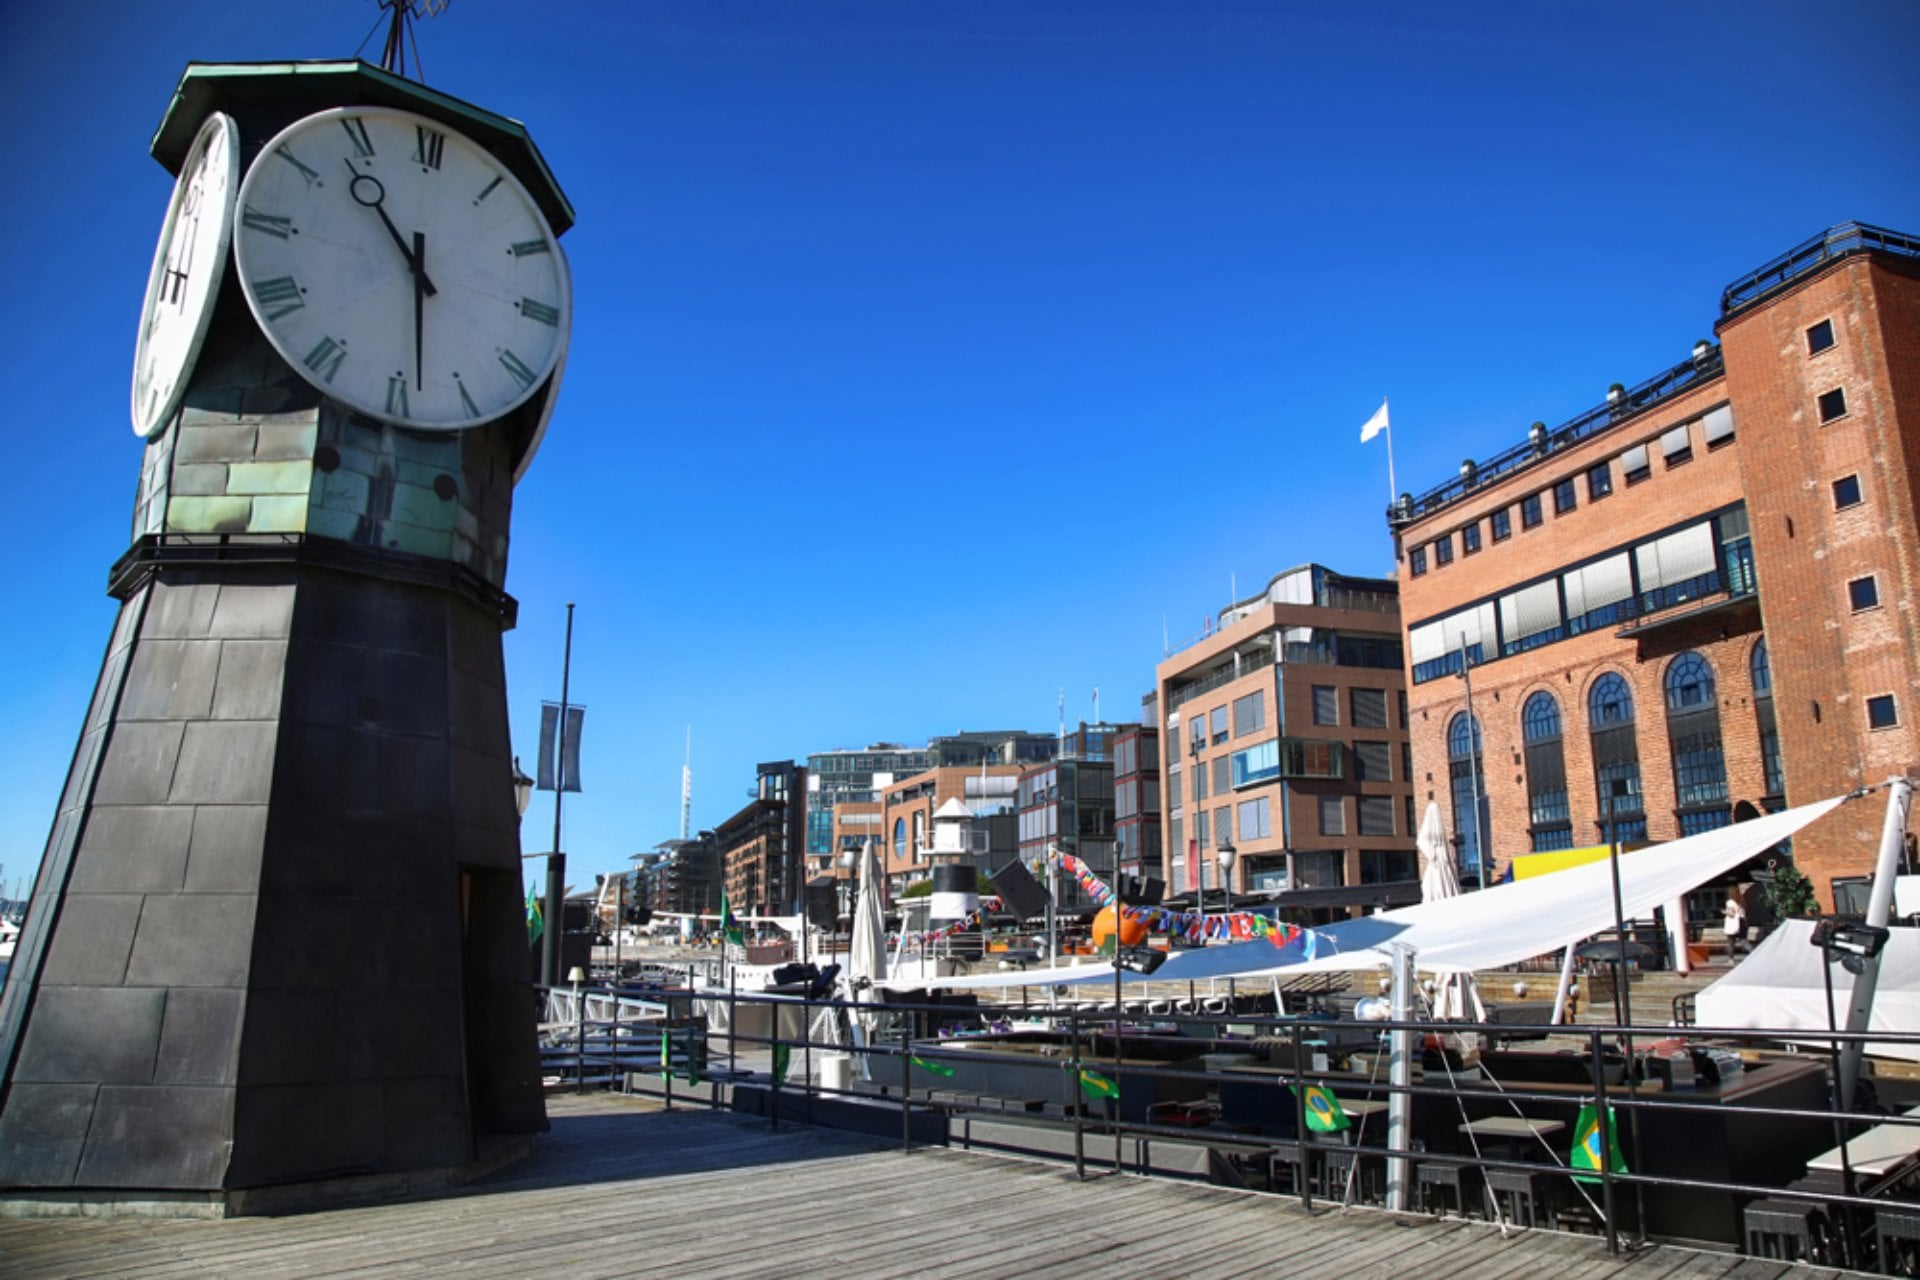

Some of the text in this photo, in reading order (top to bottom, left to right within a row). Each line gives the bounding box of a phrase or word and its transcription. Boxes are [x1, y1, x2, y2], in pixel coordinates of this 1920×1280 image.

[339, 118, 375, 158] XI
[411, 125, 445, 170] XII
[274, 142, 319, 183] X
[477, 176, 503, 201] I
[242, 204, 291, 240] IX
[511, 239, 549, 257] II
[252, 276, 305, 322] VIII
[521, 297, 559, 327] III
[303, 335, 347, 384] VII
[498, 349, 537, 392] IV
[385, 376, 410, 419] VI
[457, 380, 482, 420] V
